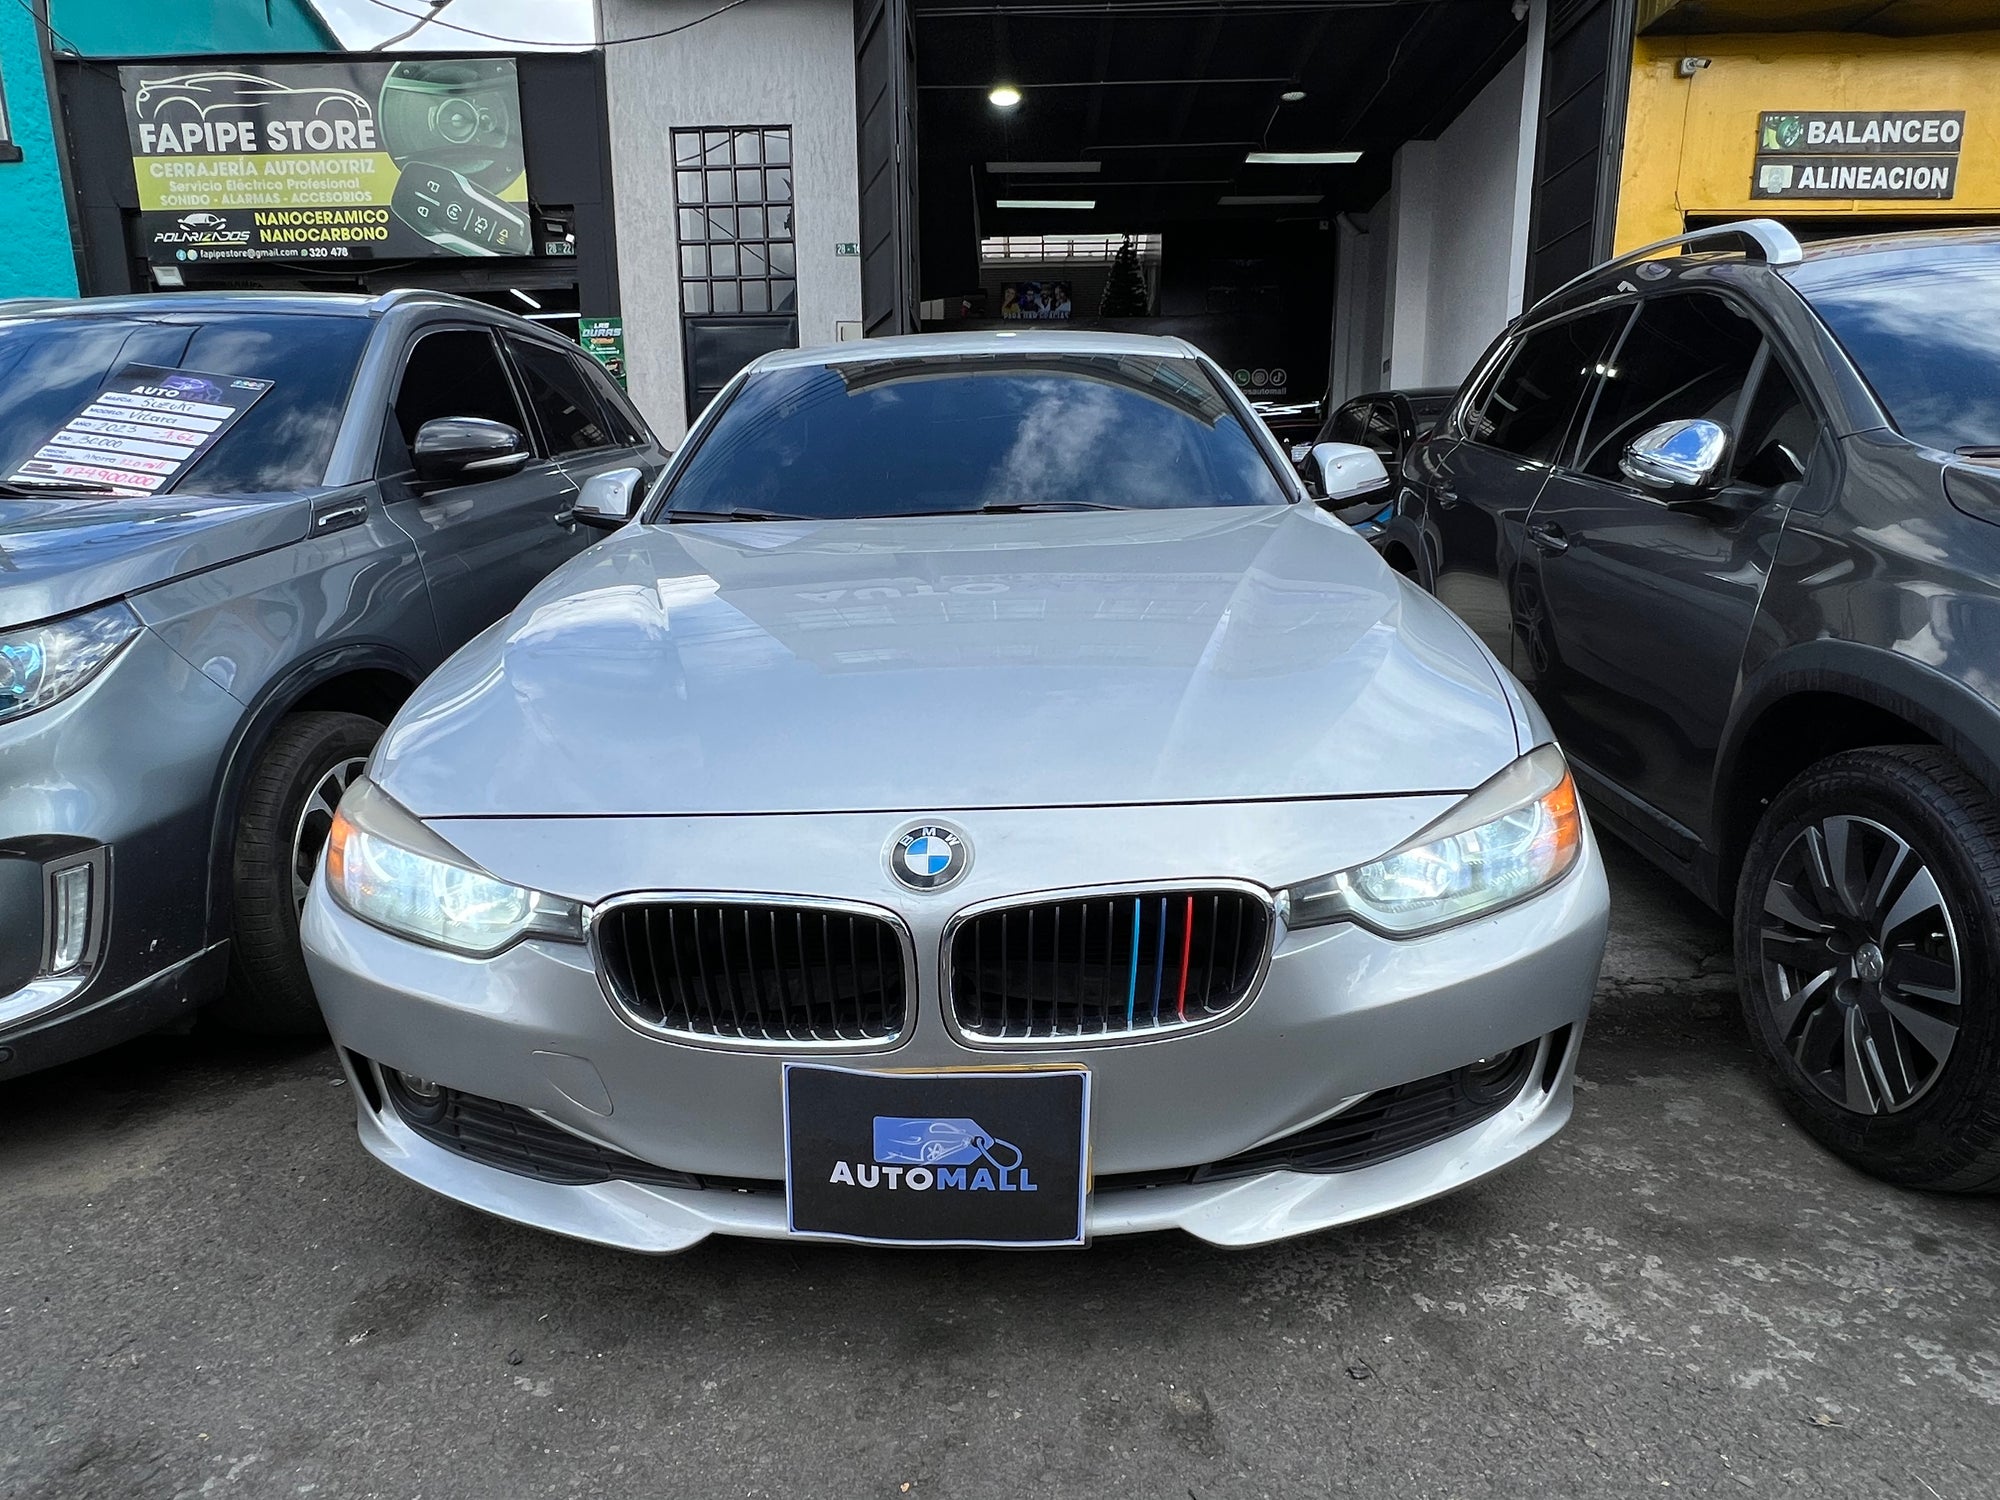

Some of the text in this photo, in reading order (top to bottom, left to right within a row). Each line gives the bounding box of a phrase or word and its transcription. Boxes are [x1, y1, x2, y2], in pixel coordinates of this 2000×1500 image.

[138, 119, 376, 154] FAPIPE STORE
[1807, 119, 1960, 144] BALANCEO
[149, 157, 376, 178] CERRAJERÍA AUTOMOTRIZ
[169, 177, 360, 192] Servicio Eléctrico Profesional
[1797, 166, 1949, 190] ALINEACION
[160, 194, 210, 206] SONIDO
[221, 192, 281, 205] ALARMAS
[291, 191, 373, 203] ACCESORIOS
[254, 209, 389, 226] NANOCERAMICO
[154, 231, 251, 243] POLARIZADOS
[259, 226, 389, 243] NANOCARBONO
[200, 246, 349, 260] fapipestore@gmail.com 320 478
[582, 327, 622, 338] DURAS
[129, 409, 178, 425] Vitara
[95, 422, 138, 434] 2023
[899, 827, 960, 847] BMW
[829, 1160, 1038, 1192] AUTOMALL
